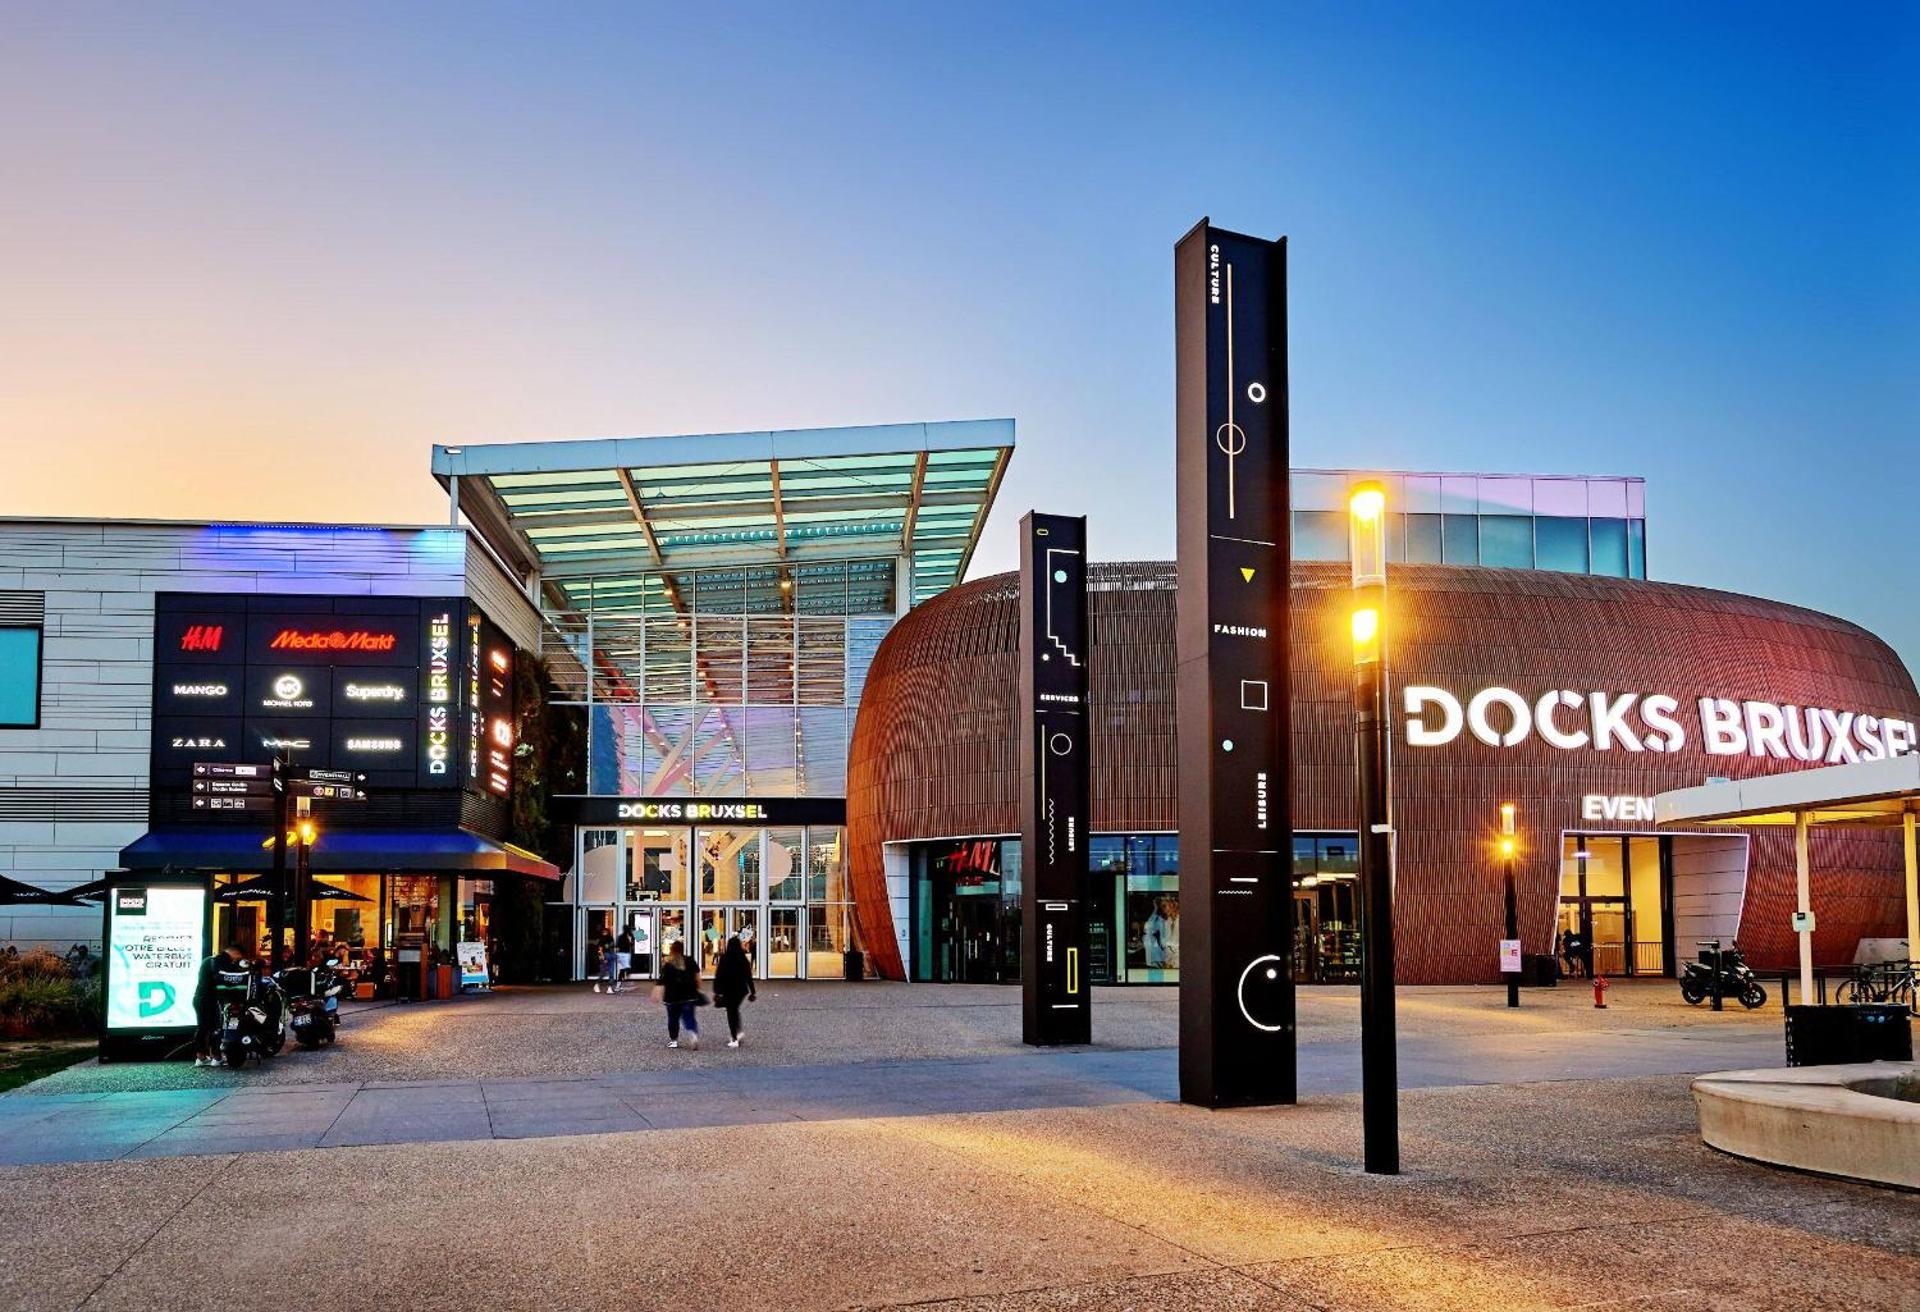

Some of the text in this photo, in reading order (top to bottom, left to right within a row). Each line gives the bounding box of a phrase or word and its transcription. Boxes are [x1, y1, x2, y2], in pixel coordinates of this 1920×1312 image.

[1210, 244, 1220, 304] CULTURE
[181, 625, 223, 650] H&M
[1213, 624, 1267, 638] FASHION
[173, 685, 228, 696] MANGO
[430, 613, 449, 775] DOCKS BRUXSEL
[1040, 693, 1079, 703] SERVICES
[1403, 685, 1686, 753] DOCKS
[172, 738, 226, 747] ZARA
[347, 739, 402, 751] SAMSUNG
[1257, 772, 1267, 829] LEISURE
[1582, 796, 1655, 821] EVEN
[619, 804, 768, 819] DOCKS BRUXSEL
